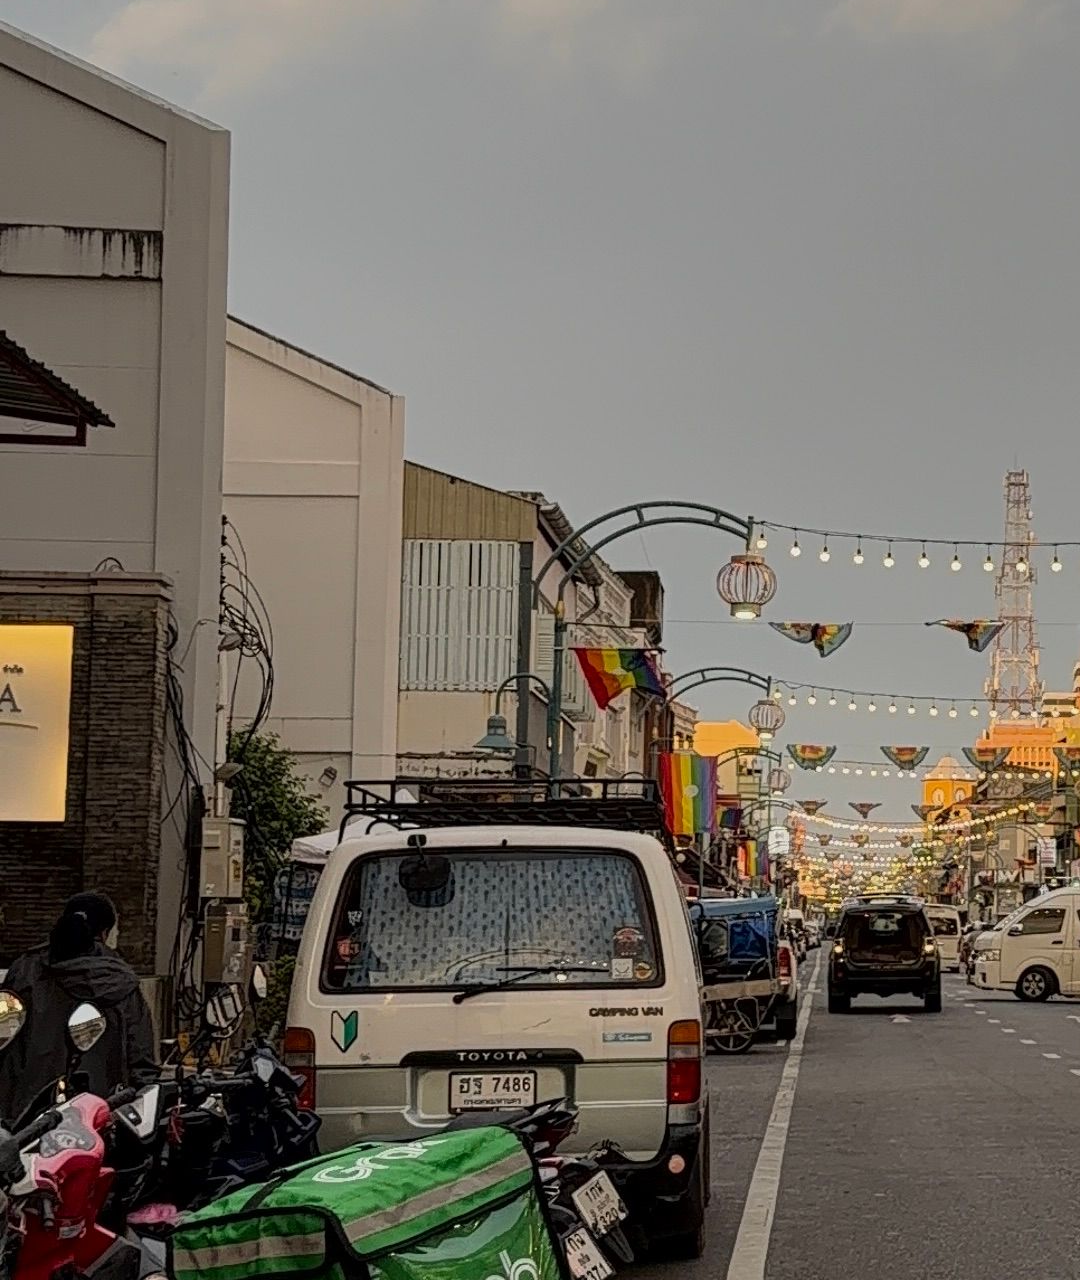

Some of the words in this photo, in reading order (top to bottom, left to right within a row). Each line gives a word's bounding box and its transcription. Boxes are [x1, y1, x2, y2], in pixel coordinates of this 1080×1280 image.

[589, 1007, 639, 1017] CAMPING
[641, 1007, 664, 1016] VAN
[457, 1051, 528, 1061] TOYOTA
[492, 1076, 531, 1093] 7486
